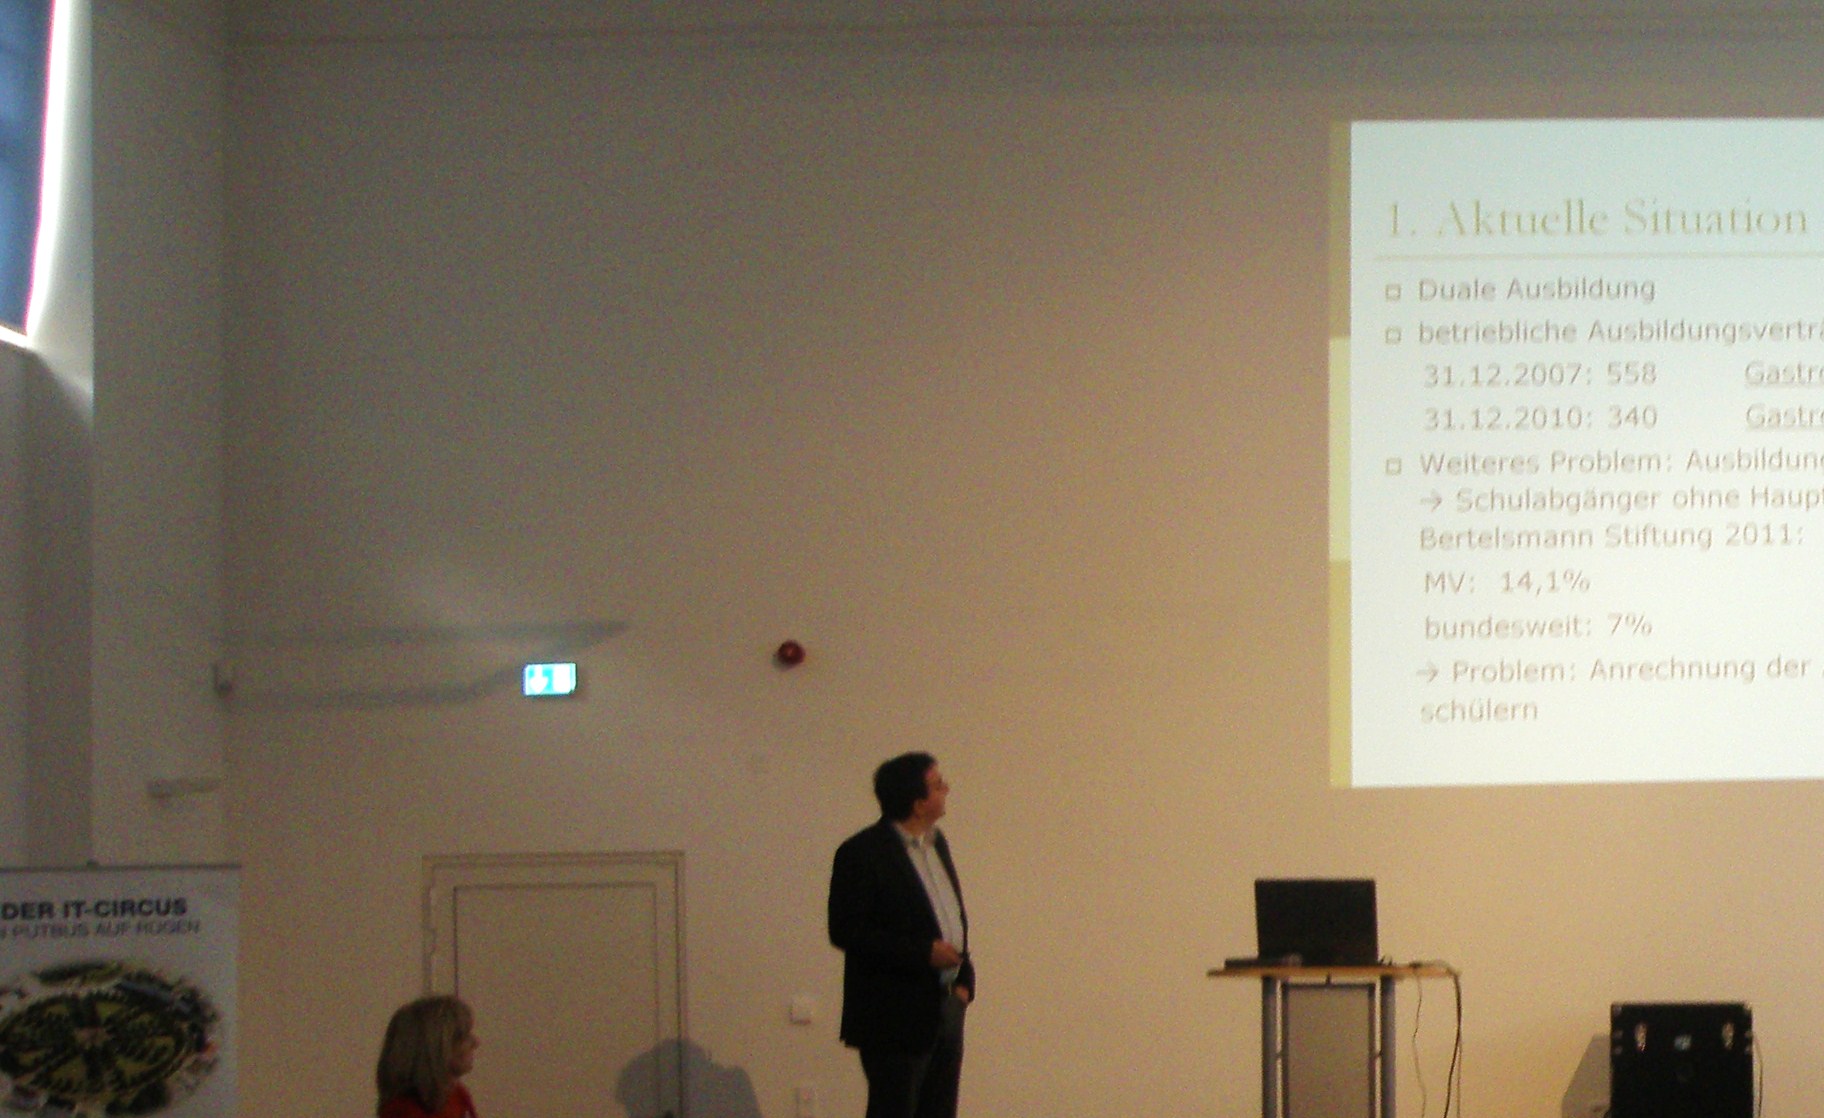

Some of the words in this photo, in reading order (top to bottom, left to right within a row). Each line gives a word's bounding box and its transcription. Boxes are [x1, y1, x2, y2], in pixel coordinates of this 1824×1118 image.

[1388, 200, 1417, 239] 1.
[1436, 196, 1609, 239] Aktuelle
[1623, 196, 1809, 237] Situation
[1417, 277, 1497, 303] Duale
[1505, 275, 1656, 306] Ausbildung
[1418, 318, 1578, 346] betriebliche
[1424, 361, 1592, 389] 31.12.2007:
[1606, 360, 1658, 387] 558
[1424, 404, 1593, 432] 31.12.2010:
[1607, 404, 1659, 430] 340
[1419, 451, 1541, 477] Weiteres
[1550, 448, 1672, 475] Problem:
[1455, 486, 1662, 517] Schulabgänger
[1671, 484, 1741, 511] ohne
[1419, 525, 1594, 552] Bertelsmann
[1604, 522, 1713, 552] Stiftung
[1724, 521, 1803, 547] 2011:
[1423, 570, 1475, 595] MV:
[1501, 568, 1591, 597] 14,1%
[1424, 614, 1592, 641] bundesweit:
[1607, 612, 1654, 637] 7%
[1452, 658, 1576, 684] Problem:
[1589, 655, 1756, 685] Anrechnung
[1765, 653, 1812, 680] der
[1420, 697, 1539, 724] schülern
[1, 901, 54, 920] DER
[63, 898, 188, 918] IT-CIRCUS
